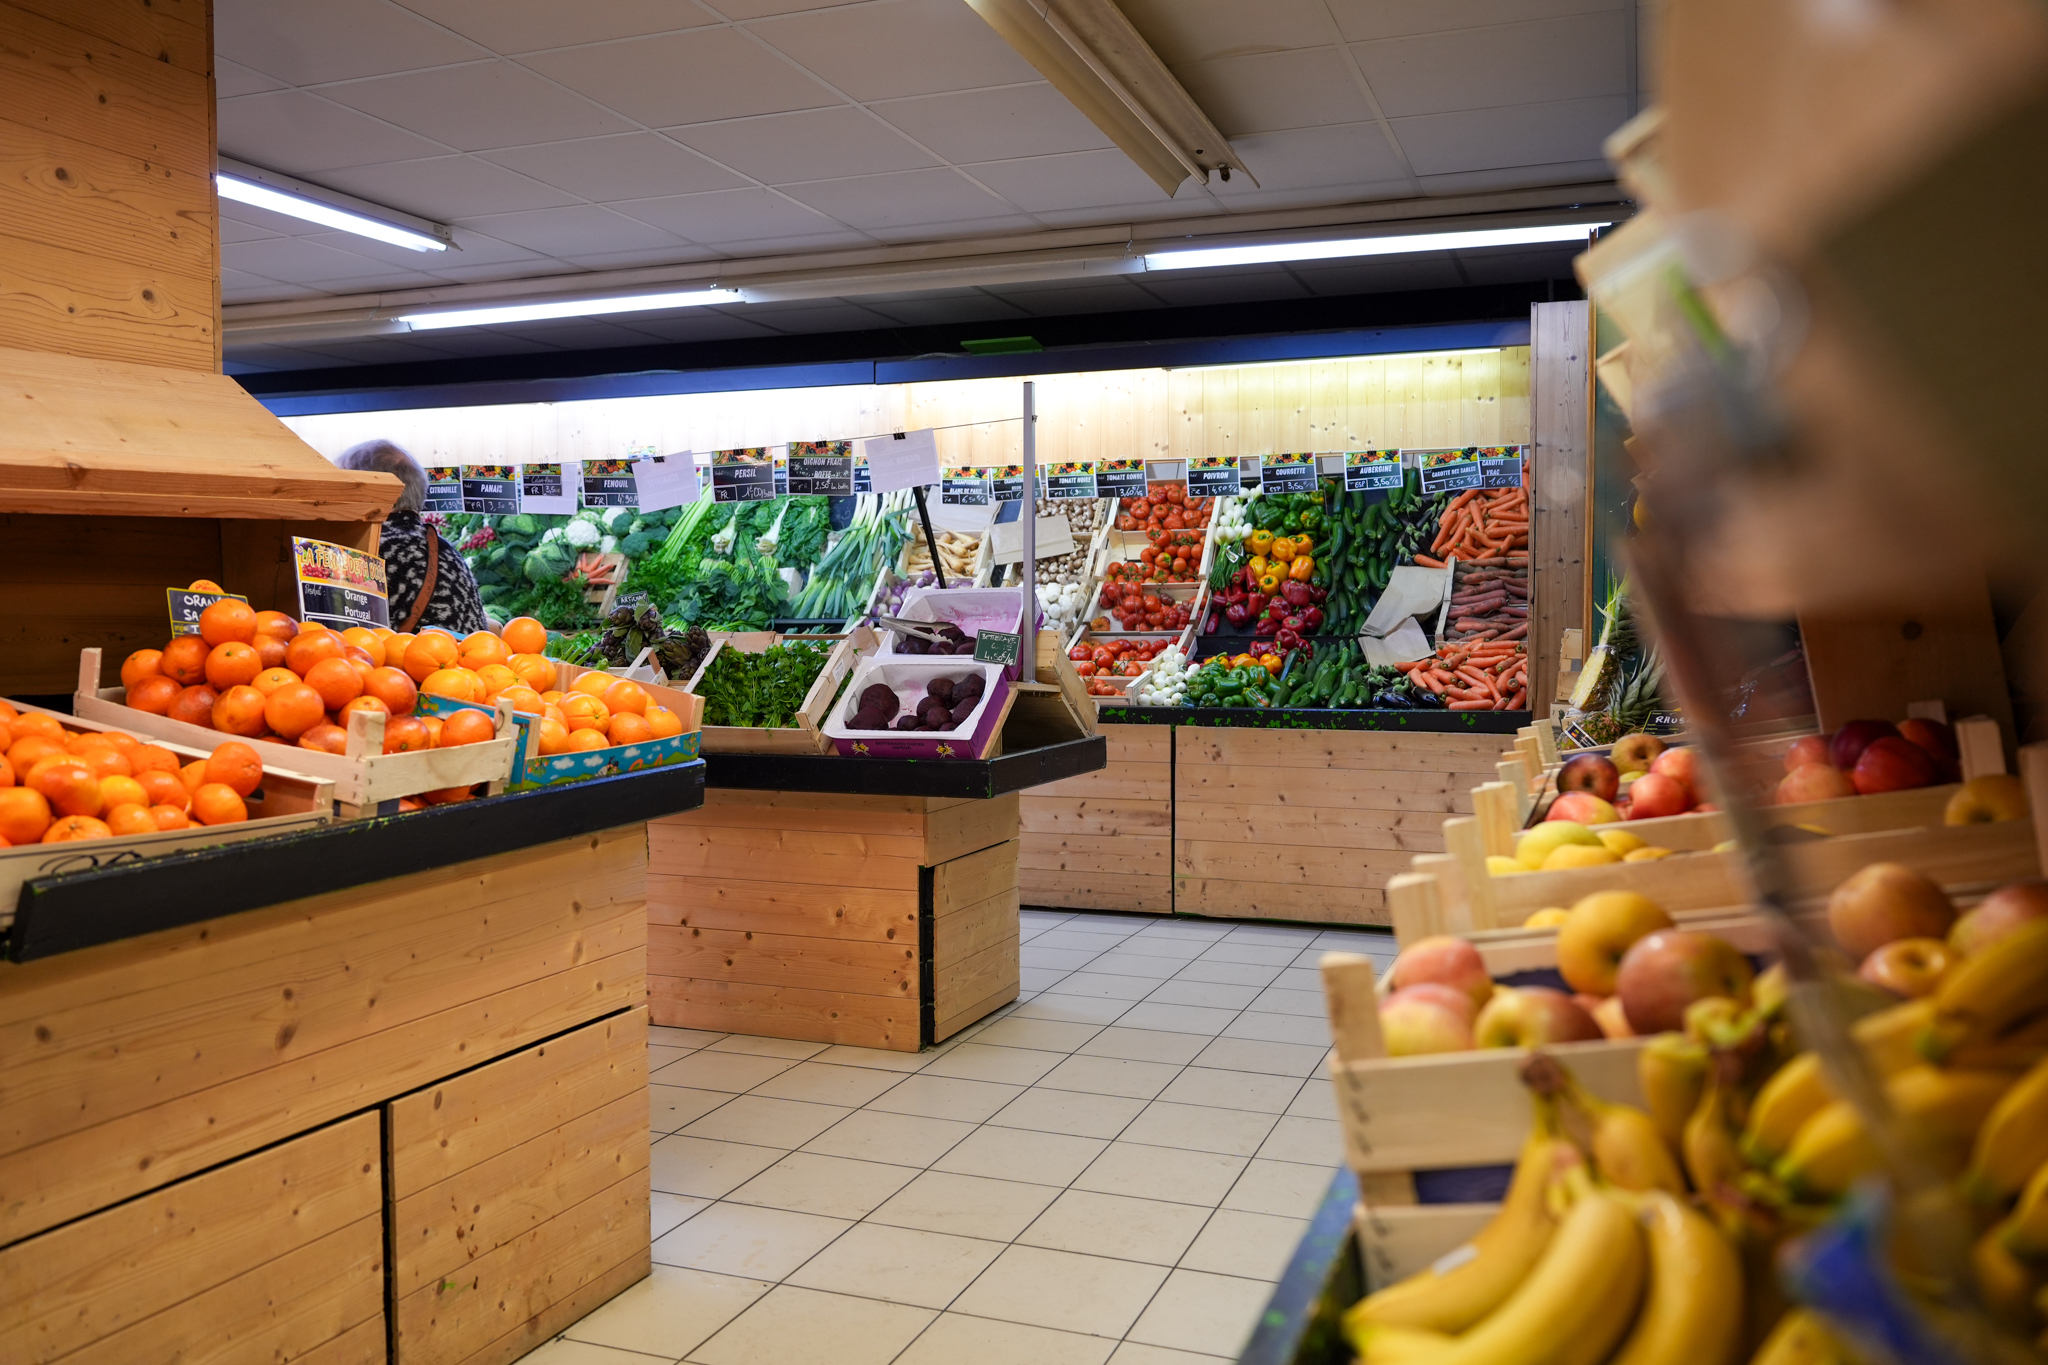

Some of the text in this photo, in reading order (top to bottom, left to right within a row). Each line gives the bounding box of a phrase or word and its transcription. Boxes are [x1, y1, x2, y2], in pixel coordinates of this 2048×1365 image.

[734, 469, 757, 478] PERSIL
[1275, 467, 1306, 476] COURGETTE
[1360, 465, 1393, 474] AUBERGINE
[1106, 474, 1126, 482] TOMATE
[1203, 471, 1229, 480] POIVRON
[603, 479, 629, 488] FENOUIL
[1058, 477, 1076, 485] TOMATE
[429, 485, 458, 495] CITROUILLE
[481, 483, 503, 494] PANAIS
[300, 546, 315, 567] LA
[344, 590, 368, 605] Orange
[344, 606, 371, 621] Portugal
